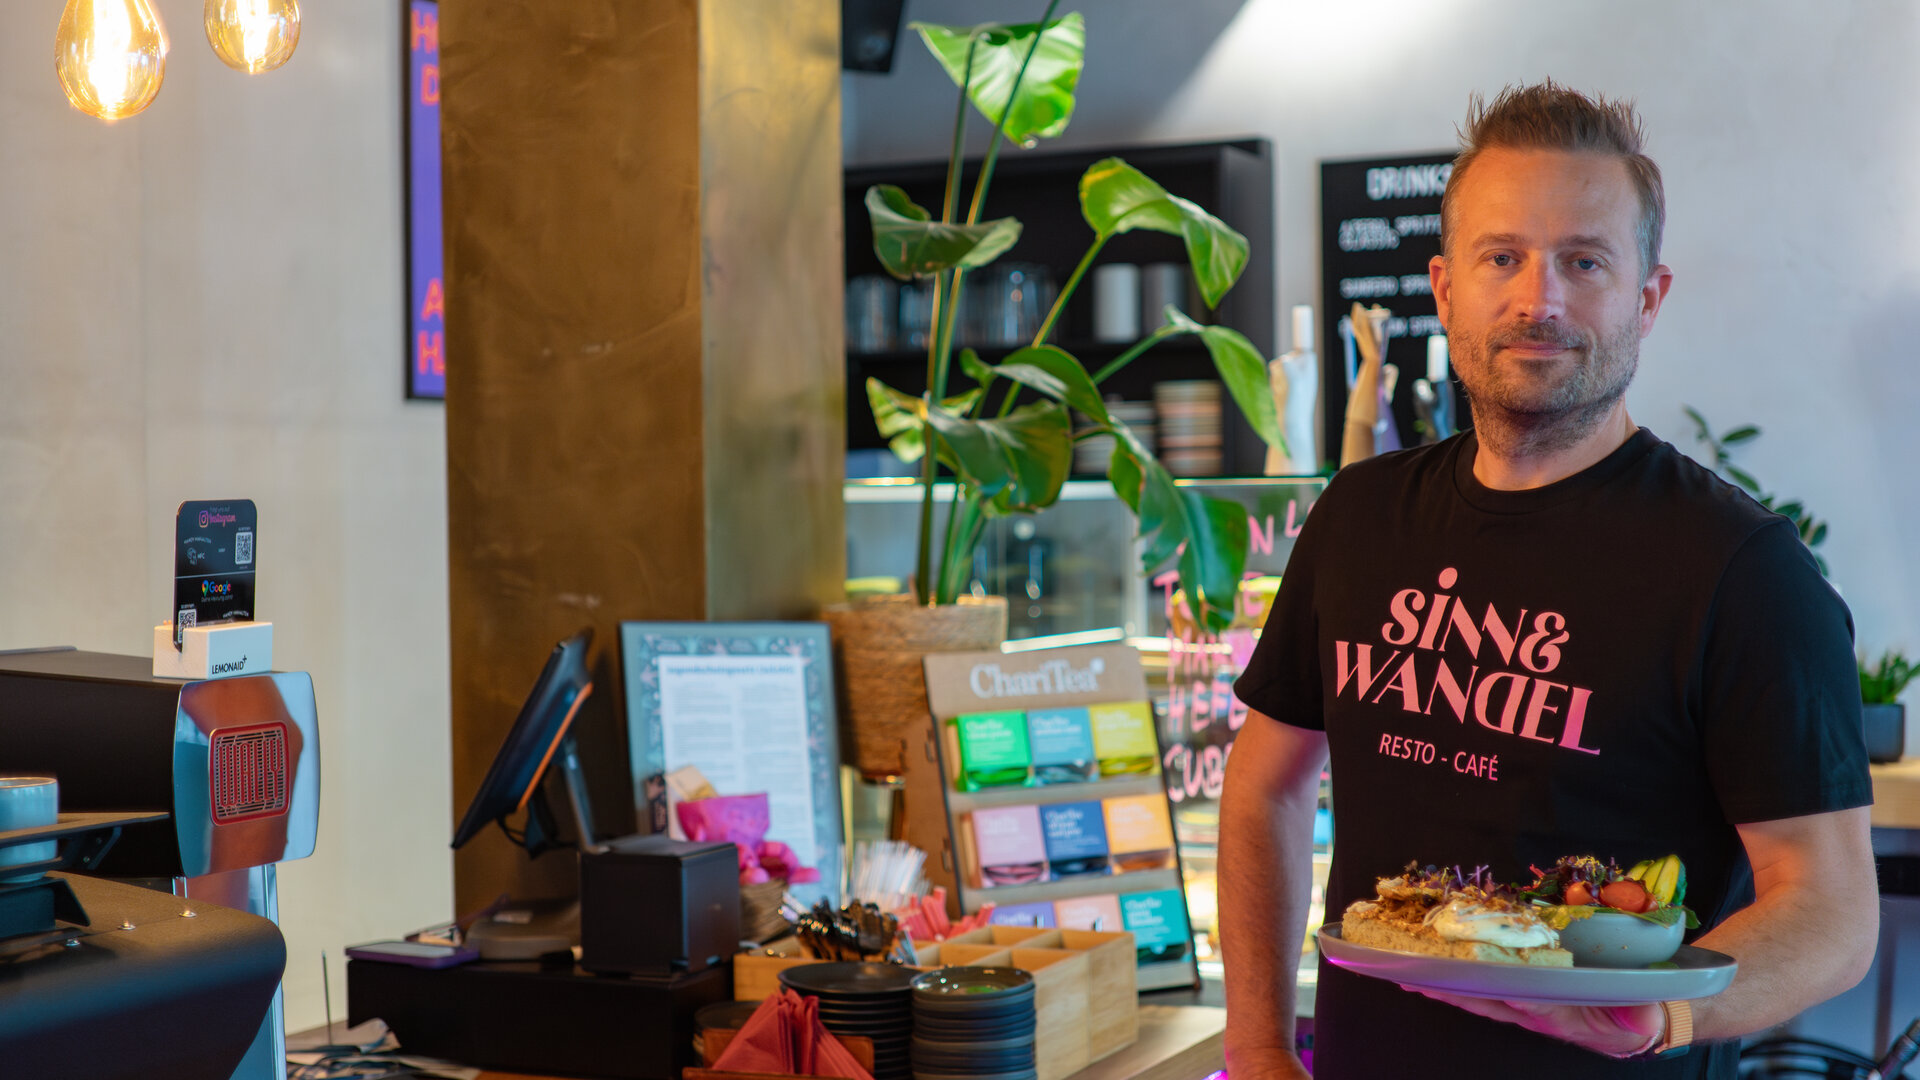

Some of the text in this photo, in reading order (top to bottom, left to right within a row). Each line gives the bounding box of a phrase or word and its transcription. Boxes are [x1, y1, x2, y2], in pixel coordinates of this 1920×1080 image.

[411, 9, 438, 54] H
[418, 330, 446, 376] H
[209, 580, 231, 595] Google
[969, 658, 1099, 699] ChariTea
[1336, 640, 1600, 756] WANDEL
[1379, 733, 1436, 765] RESTO
[1453, 751, 1500, 782] CAFÉ
